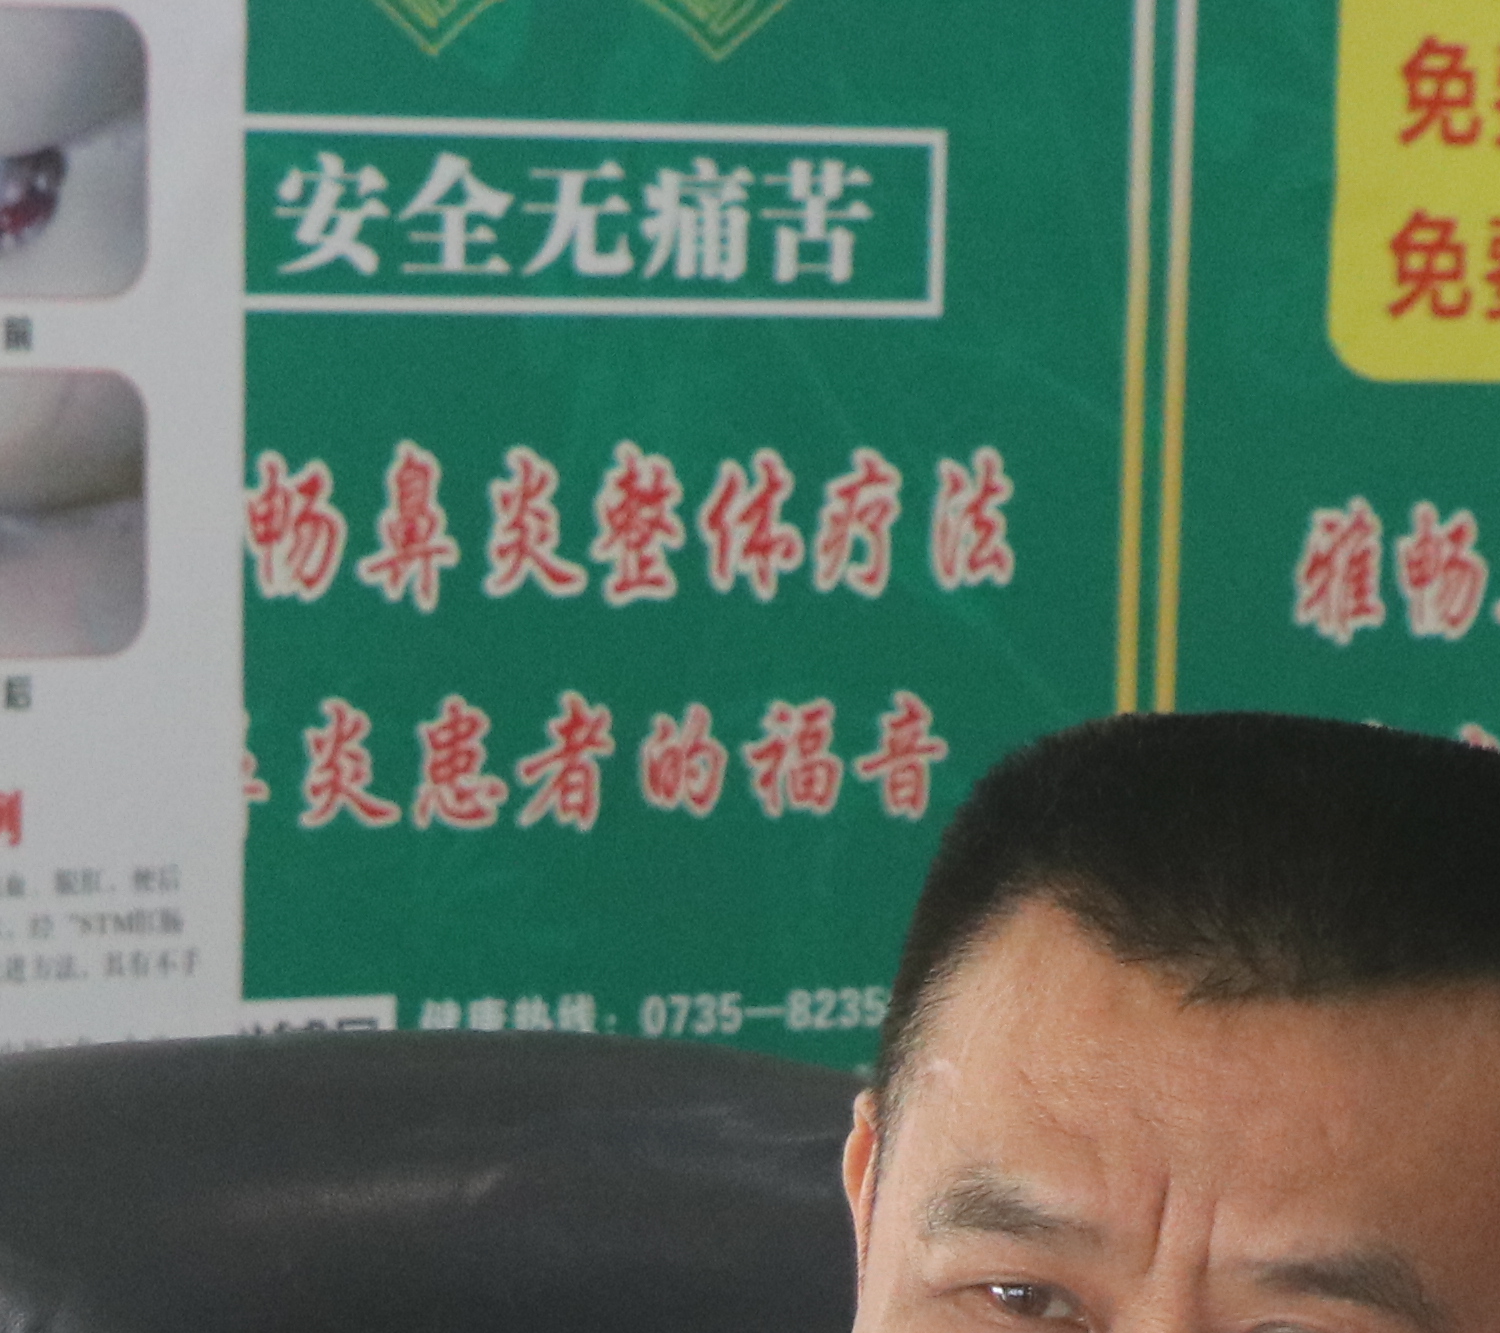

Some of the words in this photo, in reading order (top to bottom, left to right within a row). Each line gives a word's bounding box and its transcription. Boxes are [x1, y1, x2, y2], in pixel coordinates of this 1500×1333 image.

[273, 153, 874, 284] 安全无痛苦
[245, 440, 1014, 612] 畅鼻炎整体疗法
[243, 690, 948, 831] 炎患者的福音
